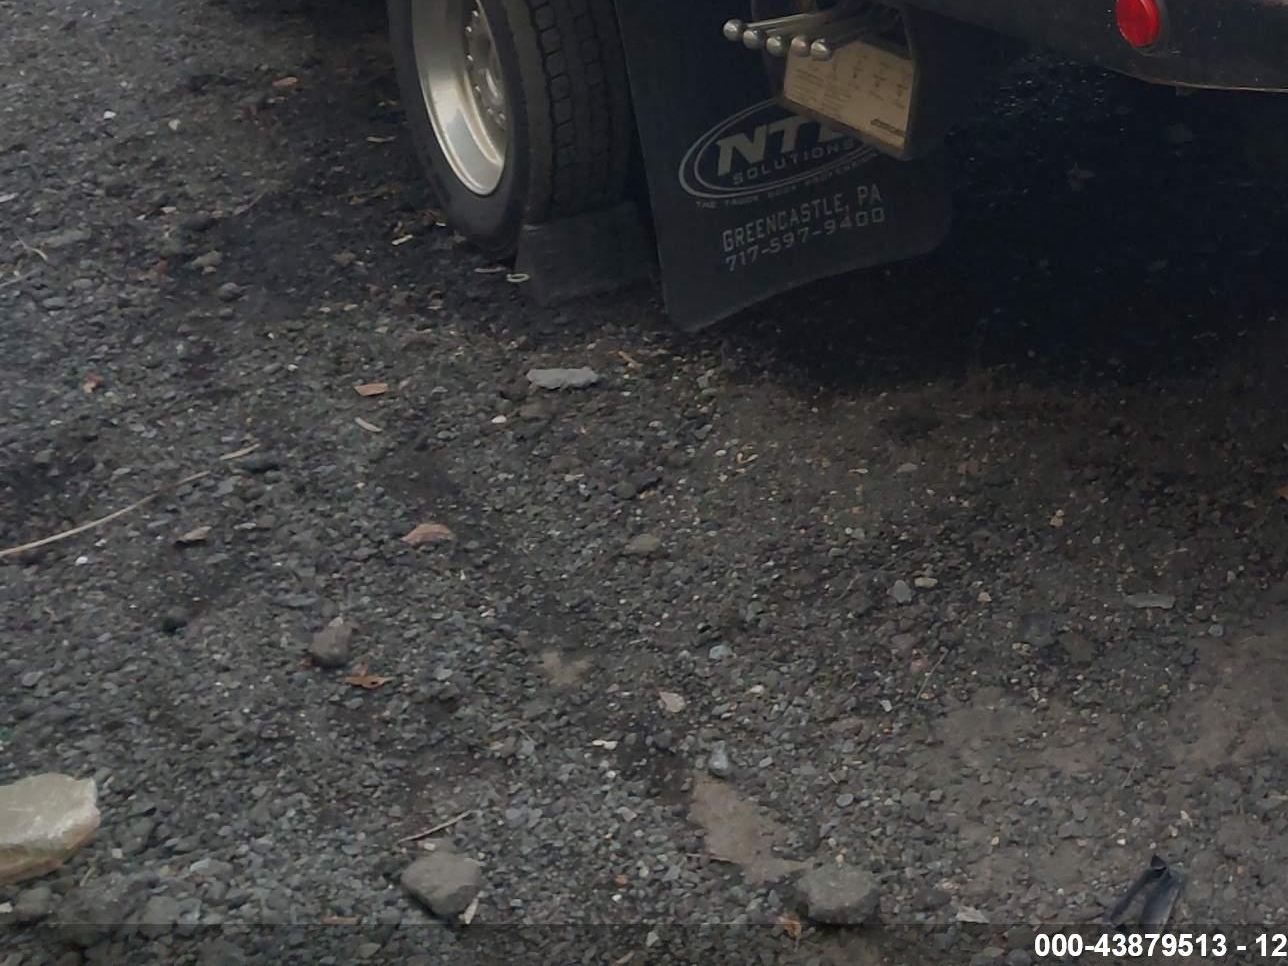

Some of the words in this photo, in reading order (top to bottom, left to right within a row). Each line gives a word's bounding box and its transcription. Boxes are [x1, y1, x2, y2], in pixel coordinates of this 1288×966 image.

[733, 141, 855, 185] SOLUTIONS
[722, 194, 851, 253] GREENCASTLE,
[856, 183, 882, 206] PA
[725, 207, 886, 272] 717-597-9400
